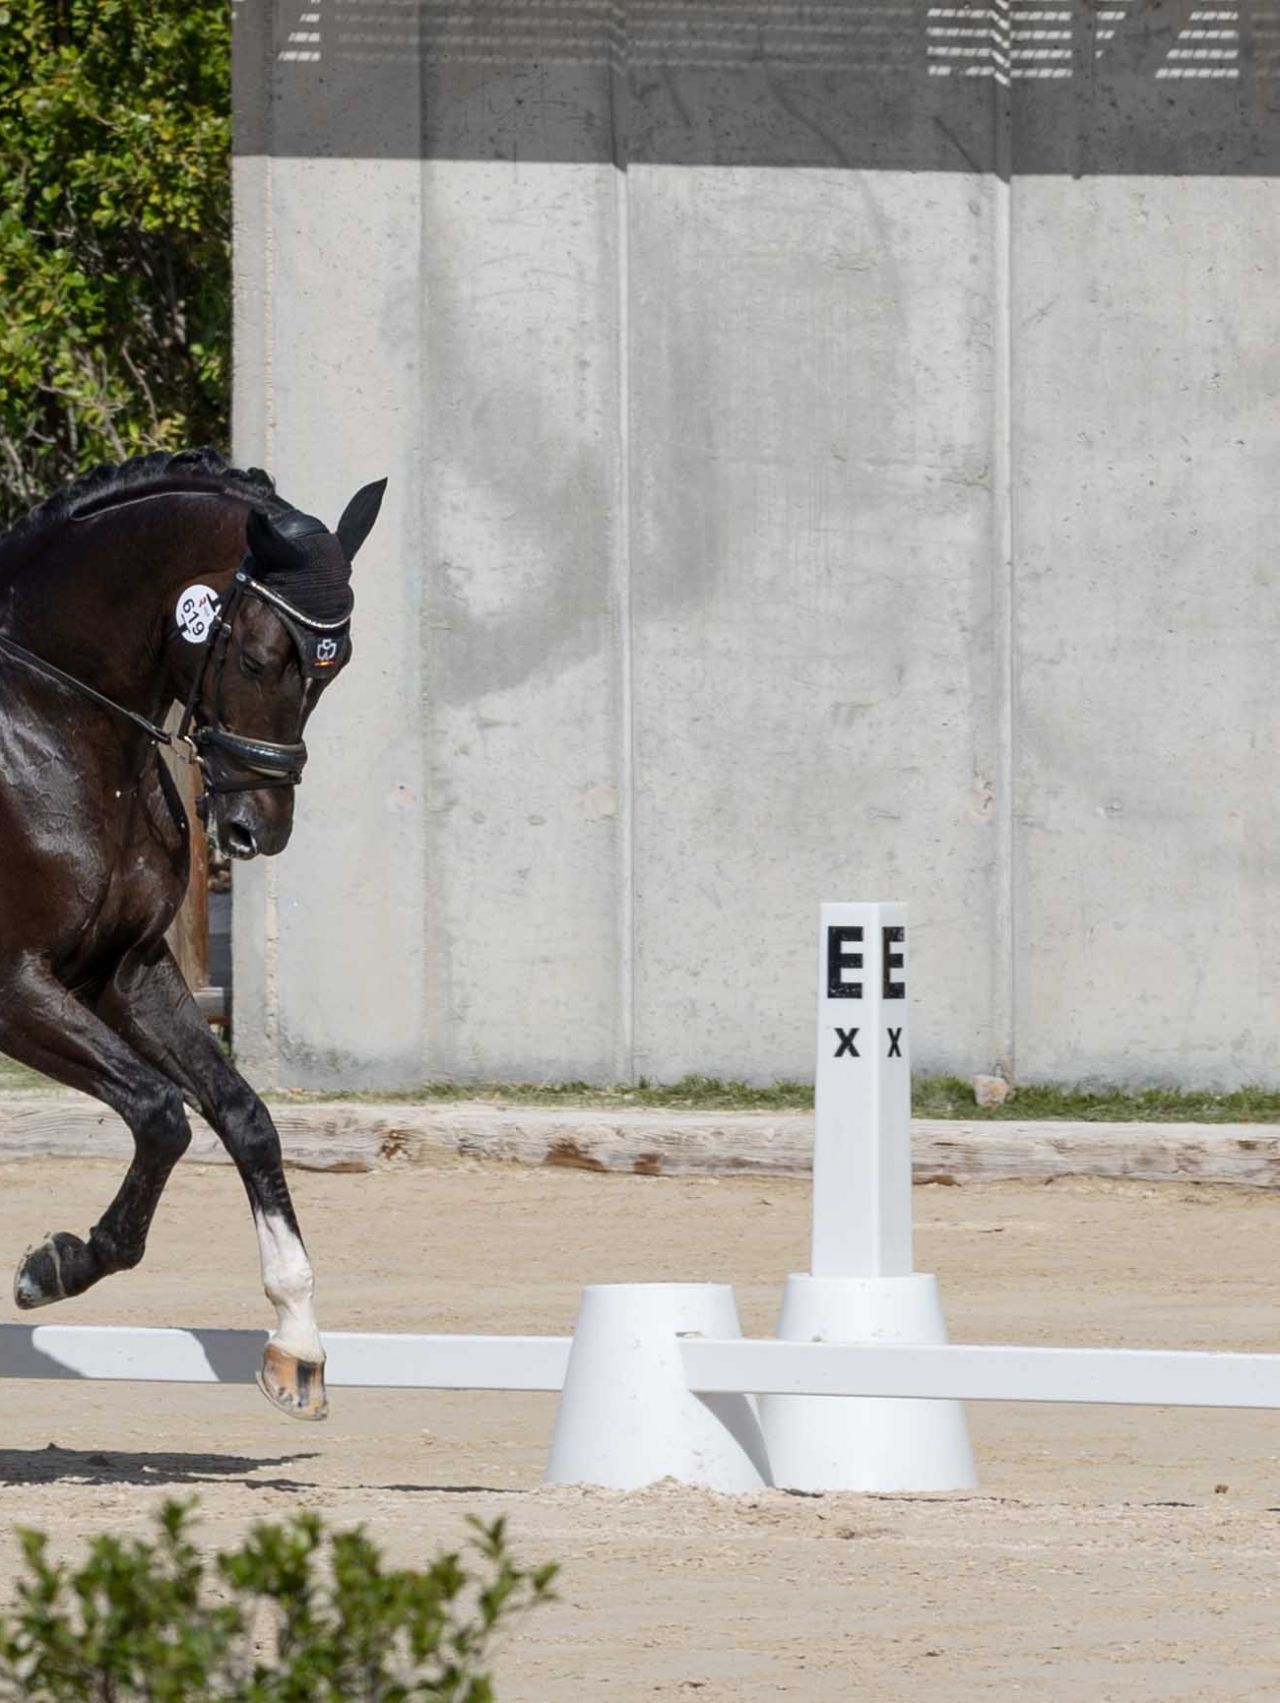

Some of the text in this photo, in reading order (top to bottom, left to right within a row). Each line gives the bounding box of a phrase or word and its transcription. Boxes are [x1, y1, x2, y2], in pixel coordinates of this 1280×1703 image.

[182, 598, 205, 636] 619
[827, 926, 864, 999] E
[882, 926, 906, 999] E
